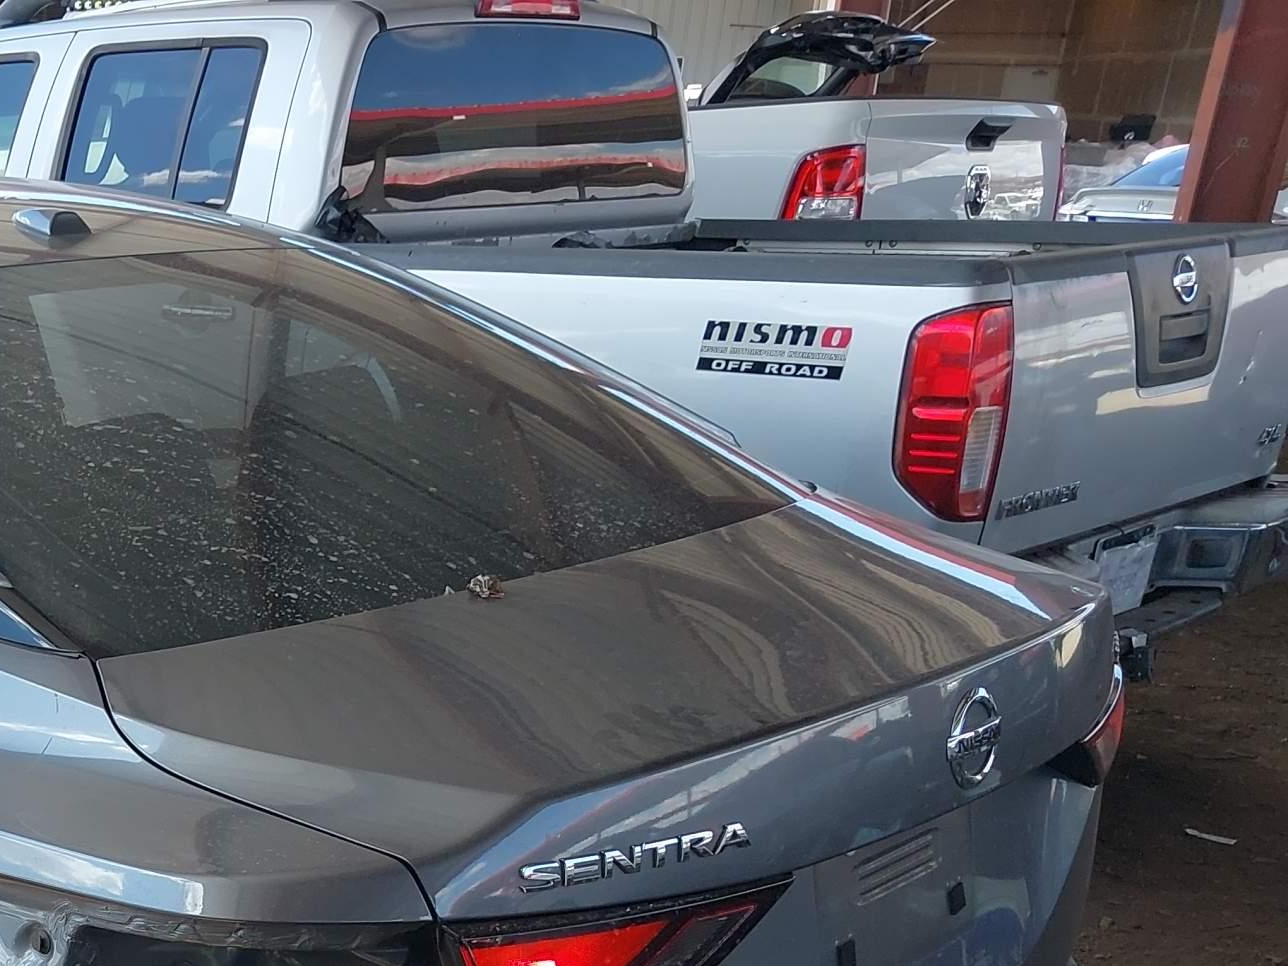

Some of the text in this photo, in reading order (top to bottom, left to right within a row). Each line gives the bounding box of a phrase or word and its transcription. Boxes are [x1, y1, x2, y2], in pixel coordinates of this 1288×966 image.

[711, 359, 828, 378] OFF ROAD
[518, 822, 752, 894] SENTRA
